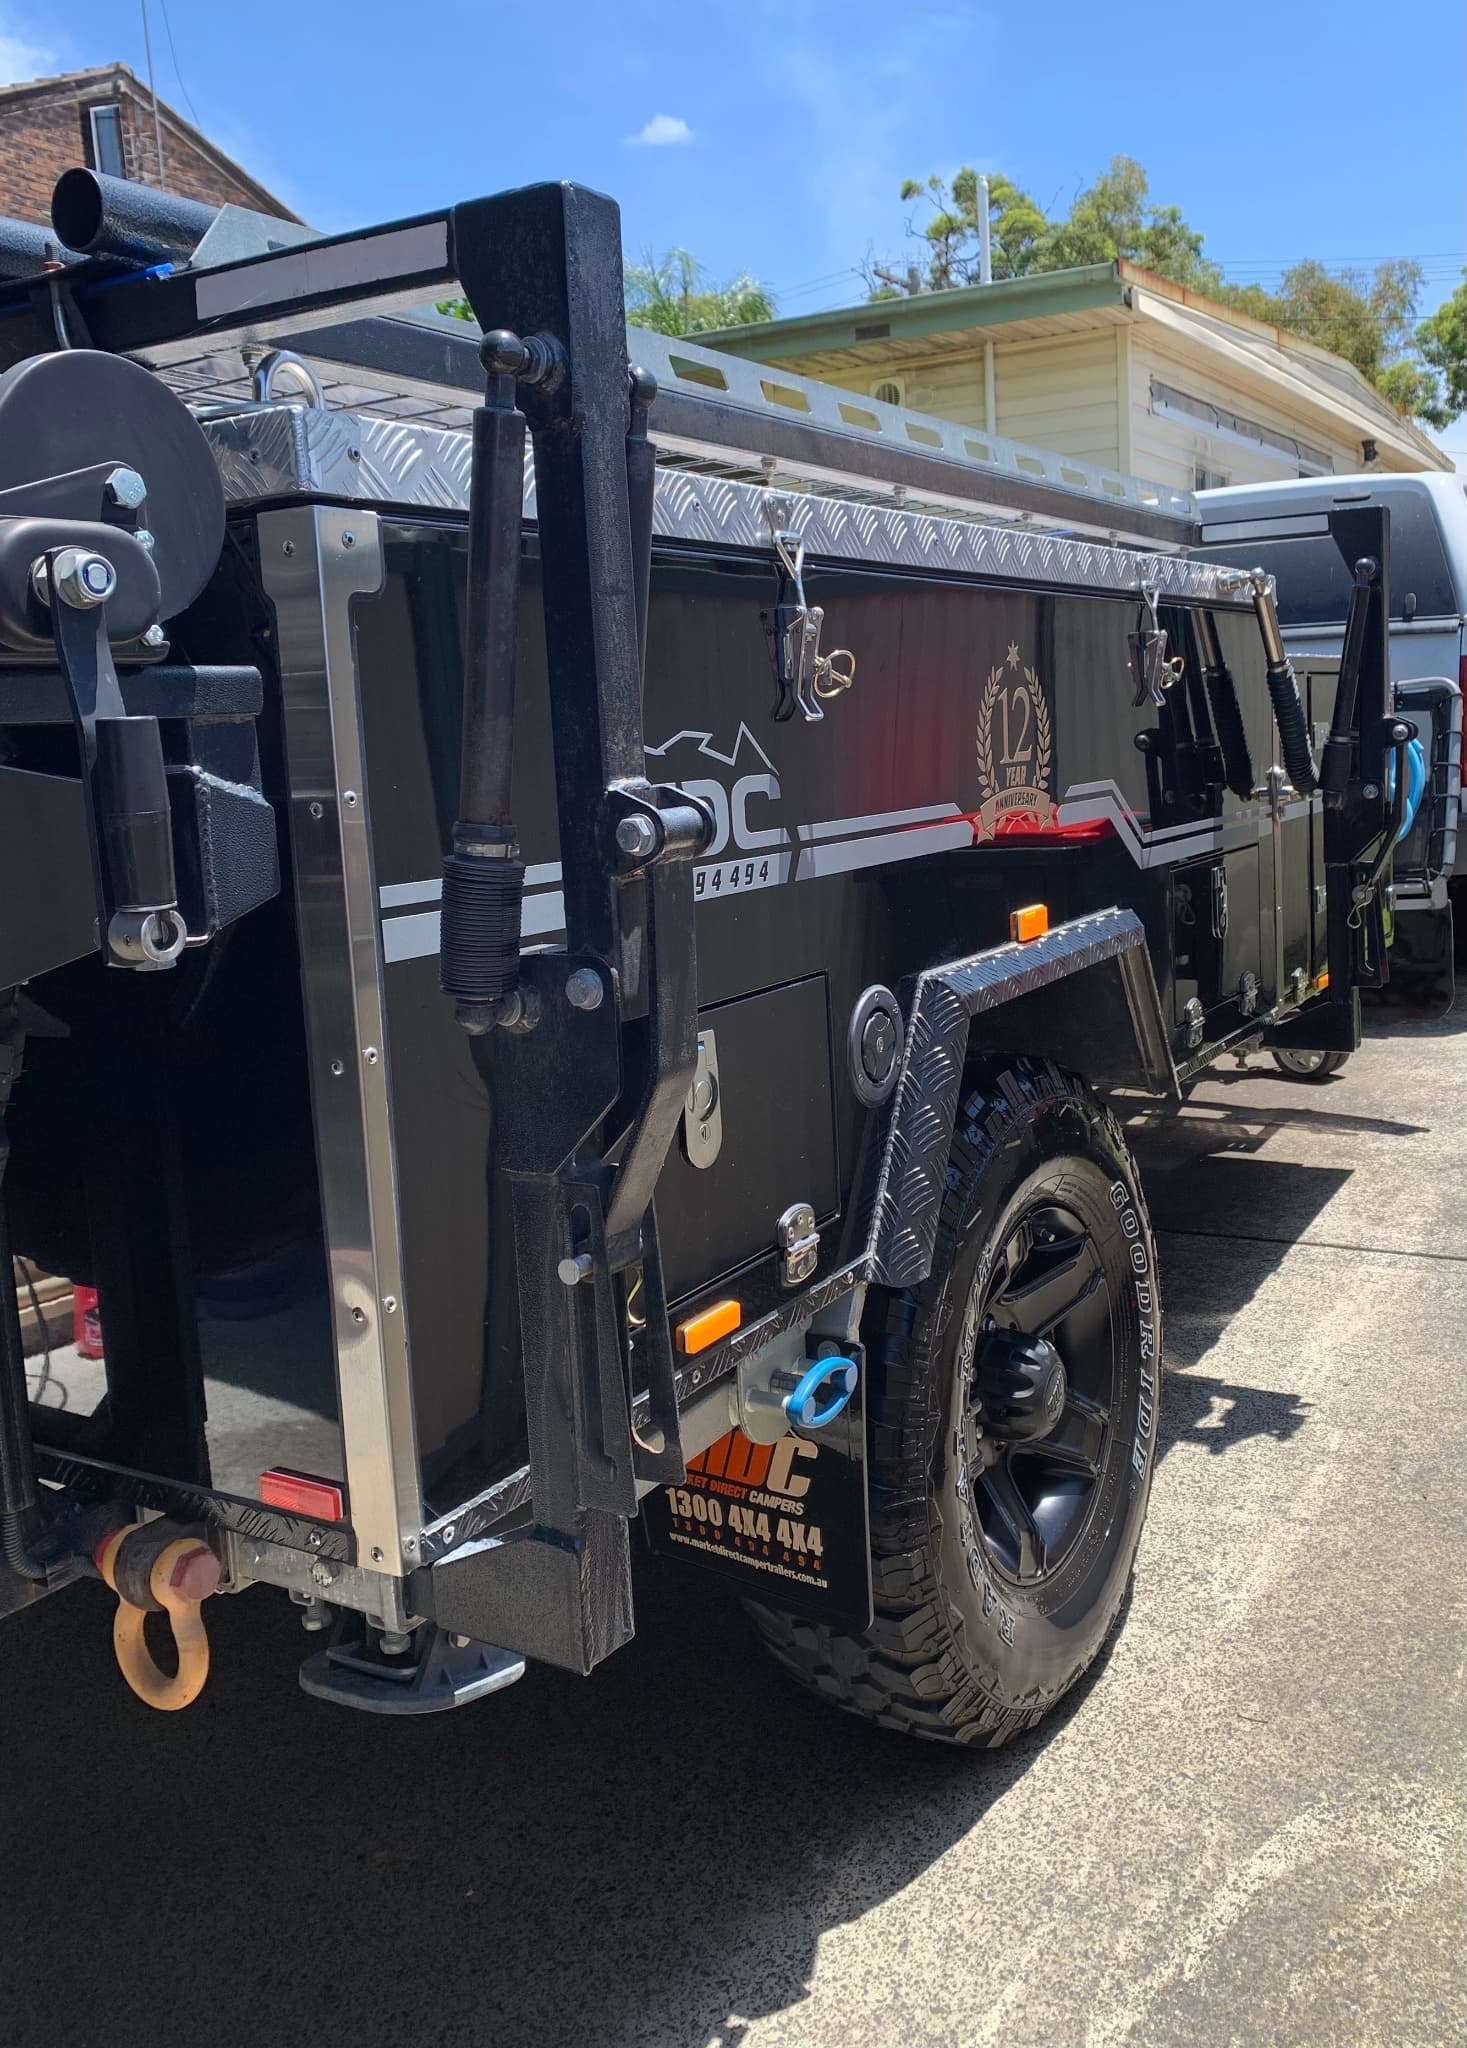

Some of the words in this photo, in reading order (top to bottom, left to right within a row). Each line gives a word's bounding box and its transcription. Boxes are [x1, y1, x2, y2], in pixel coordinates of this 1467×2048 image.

[998, 686, 1032, 764] 12
[995, 791, 1039, 809] ANNIVERSARY
[1006, 765, 1027, 787] YEAR
[652, 774, 791, 858] DC
[1109, 1180, 1155, 1481] GOODRIDE
[665, 1487, 723, 1527] 1300
[728, 1504, 771, 1543] 4X4
[776, 1518, 824, 1557] 4X4
[686, 1474, 709, 1489] KET
[710, 1480, 748, 1500] DIRECT
[749, 1490, 805, 1516] CAMPERS
